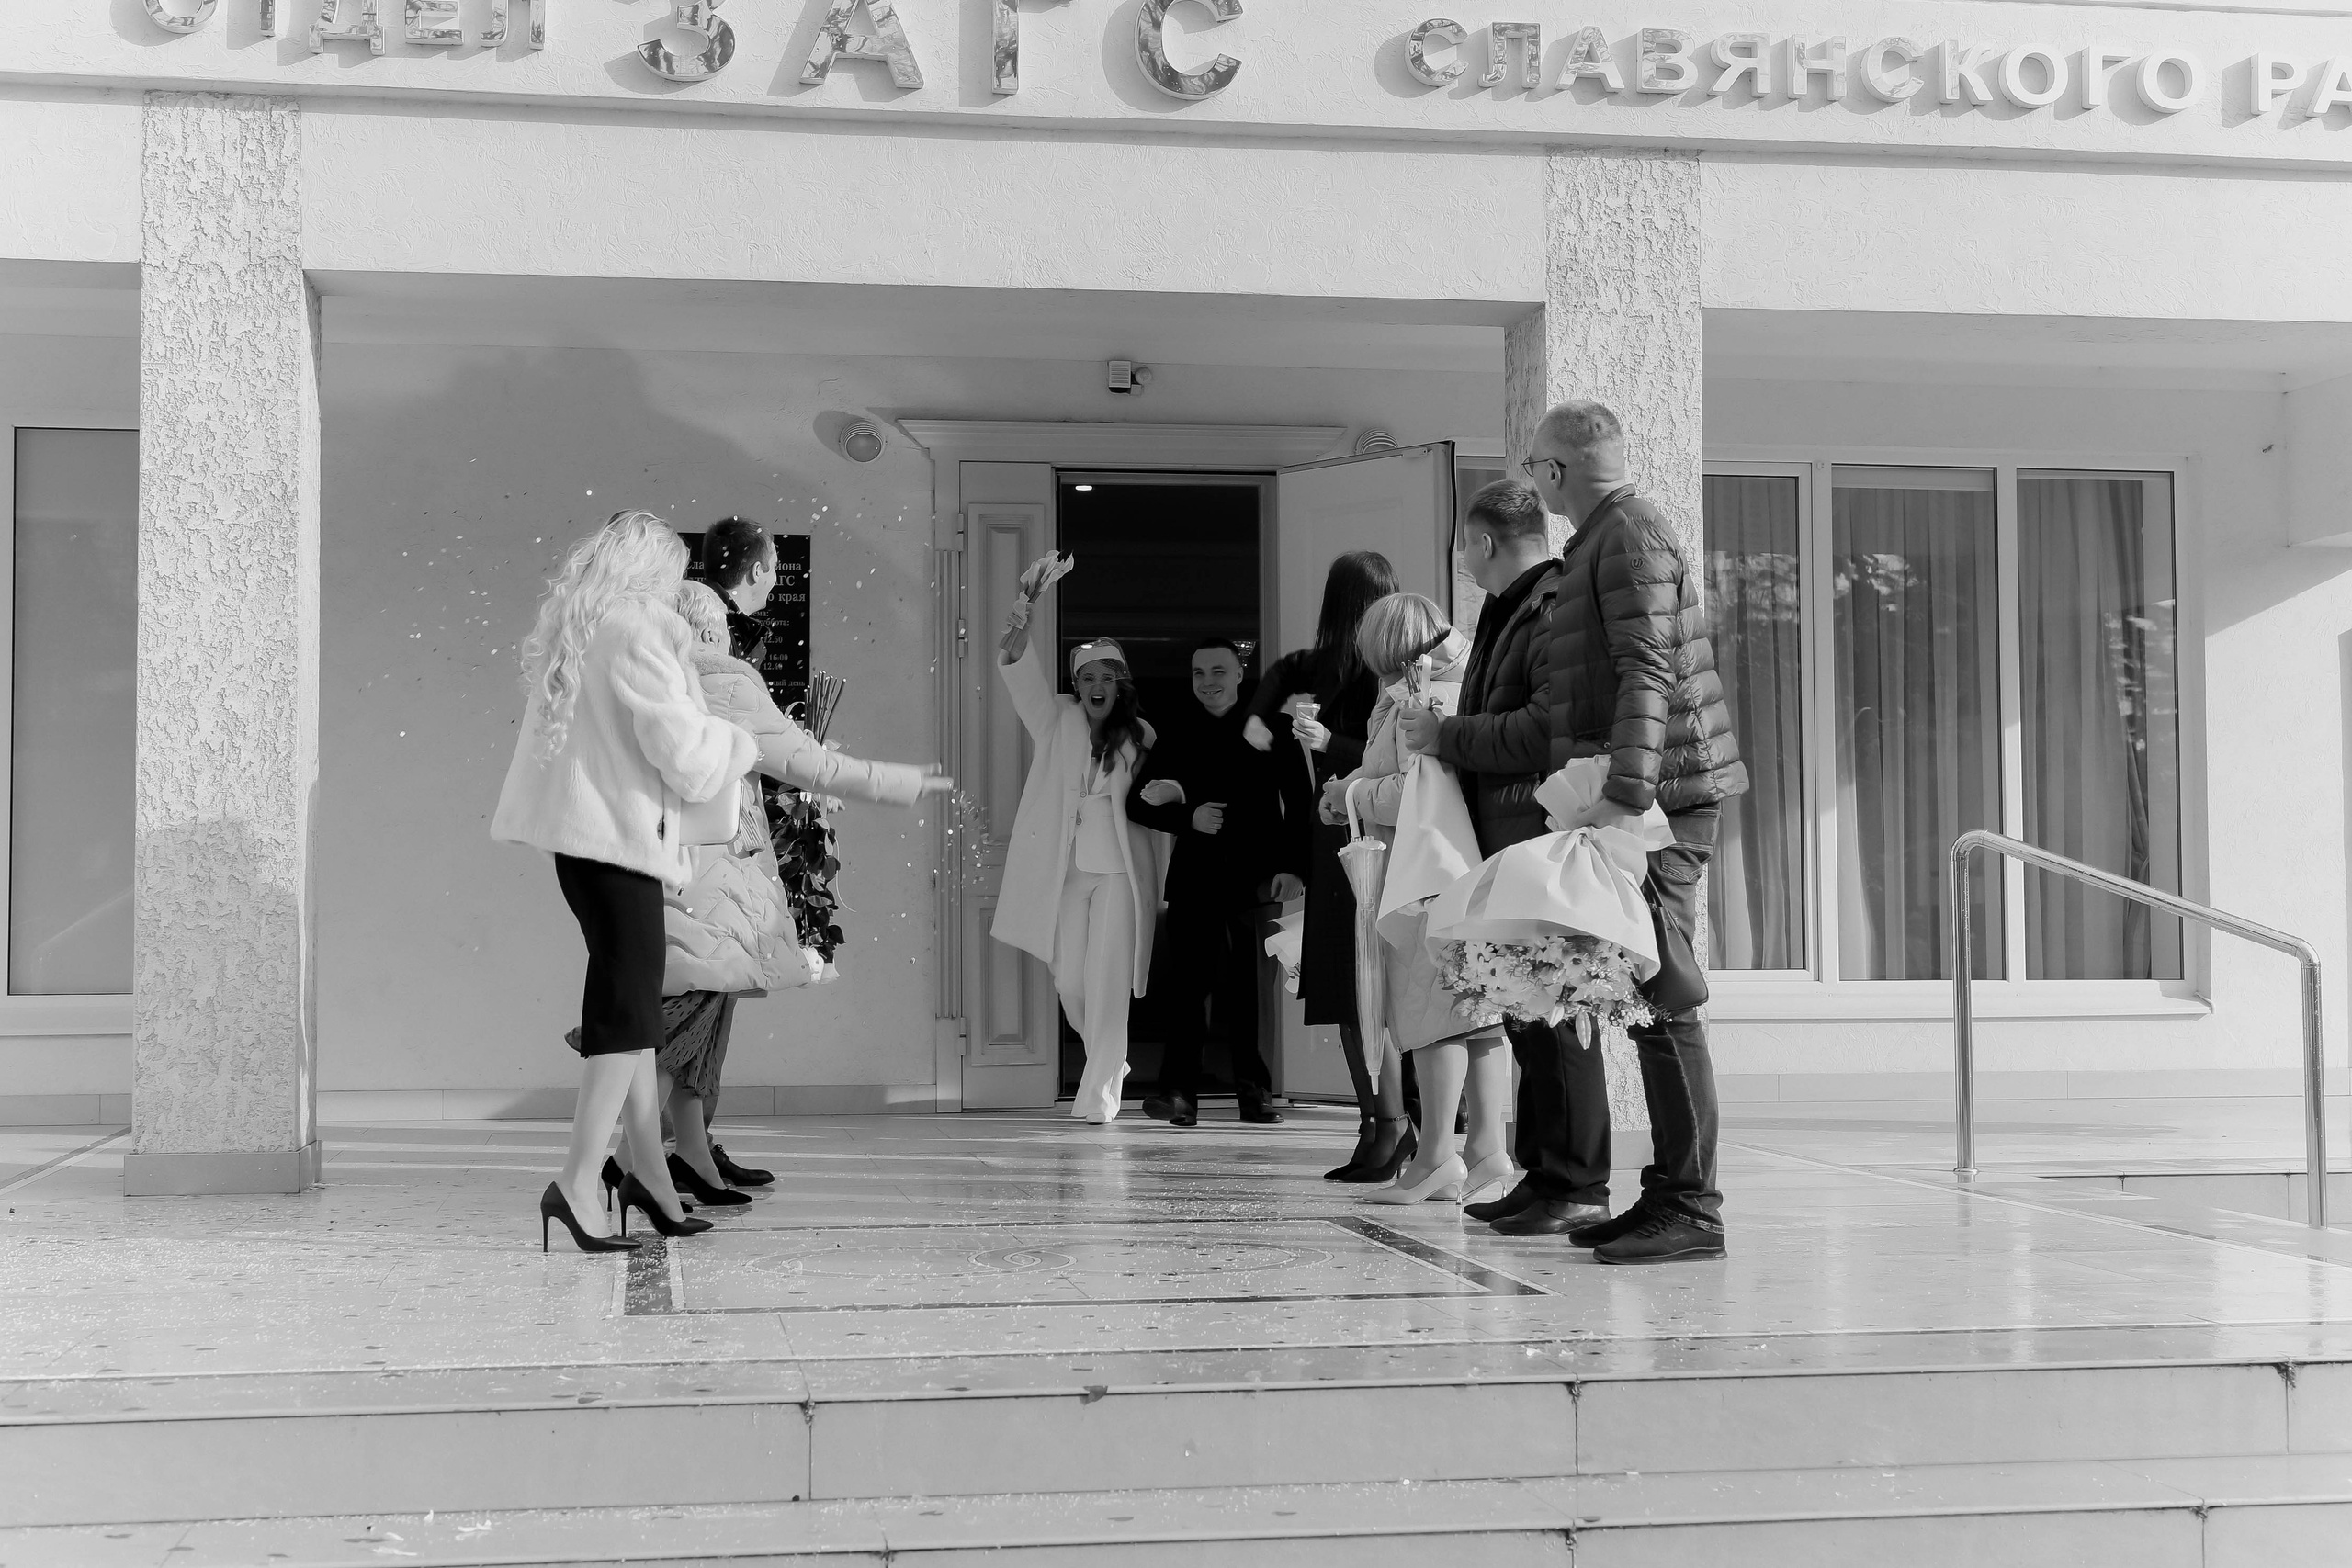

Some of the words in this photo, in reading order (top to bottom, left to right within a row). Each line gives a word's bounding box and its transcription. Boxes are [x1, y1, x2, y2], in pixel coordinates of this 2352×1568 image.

[637, 0, 1244, 100] ЗАГС
[1405, 17, 2206, 115] СЛАВЯНСКОГО
[778, 593, 806, 604] края
